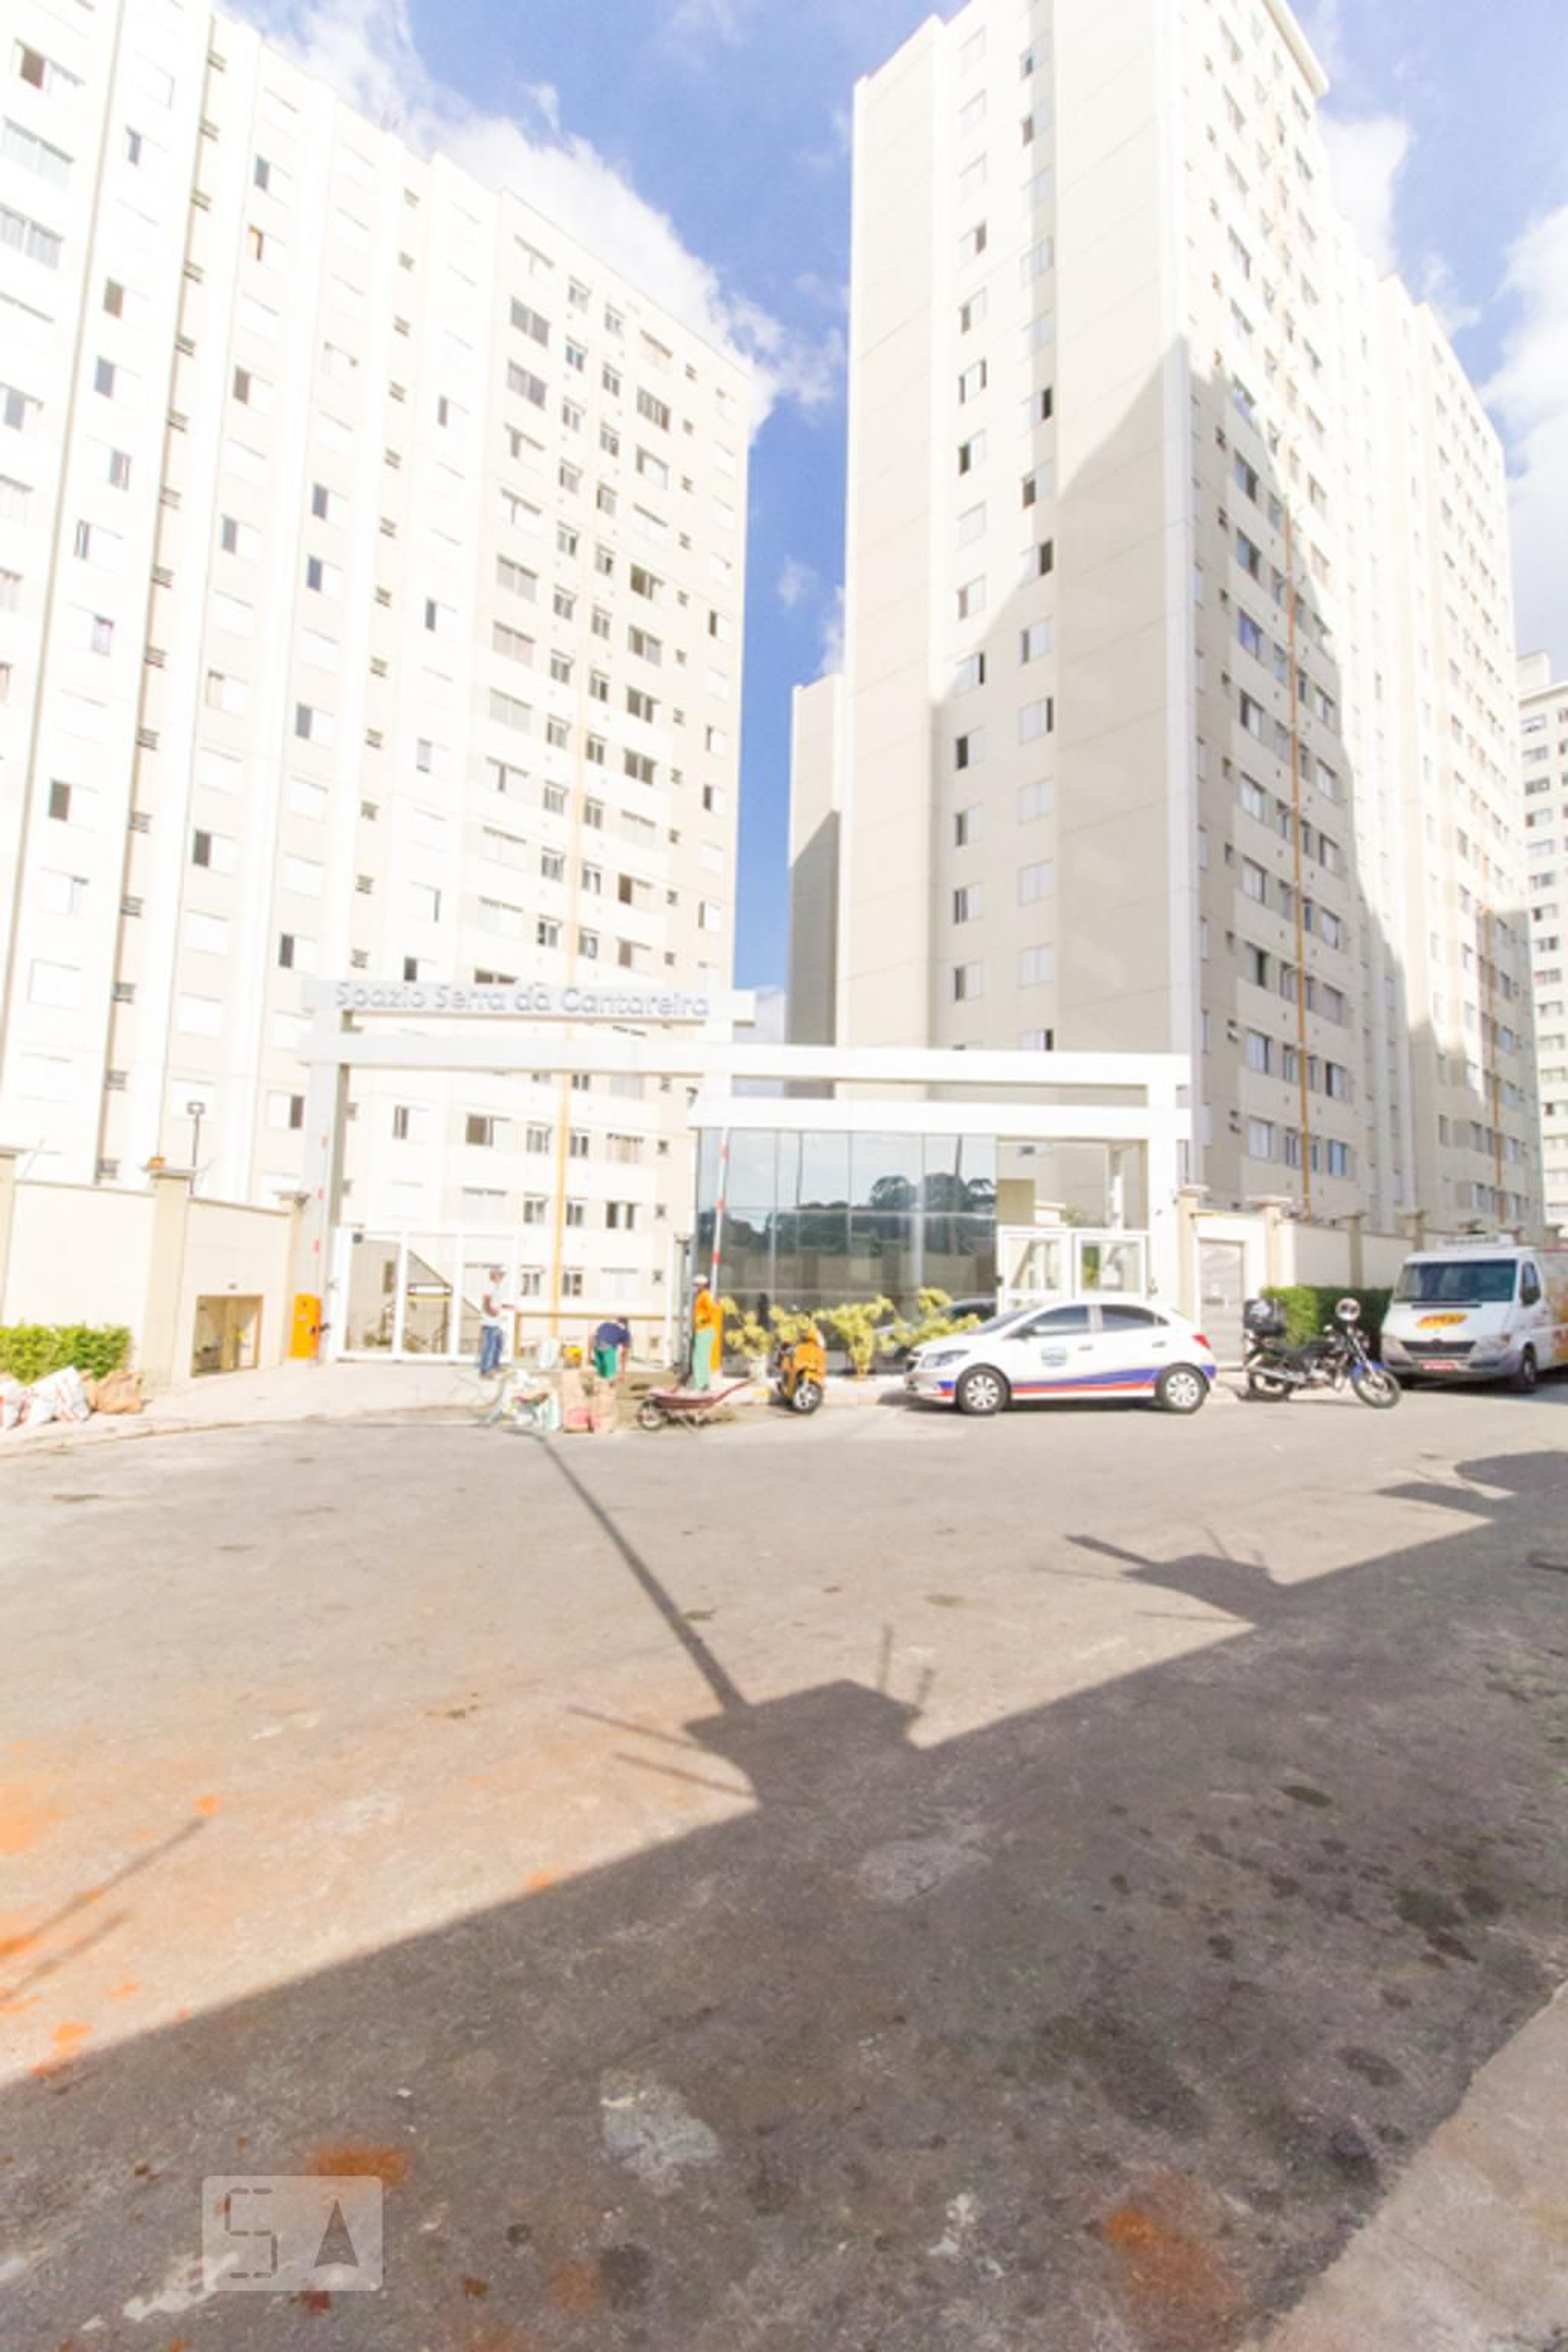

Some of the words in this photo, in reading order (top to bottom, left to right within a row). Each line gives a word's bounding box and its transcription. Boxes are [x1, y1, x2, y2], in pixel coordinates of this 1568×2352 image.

[335, 982, 425, 1007] Spazio
[434, 985, 506, 1011] Serra
[514, 984, 551, 1012] da
[561, 987, 710, 1016] Cantareira
